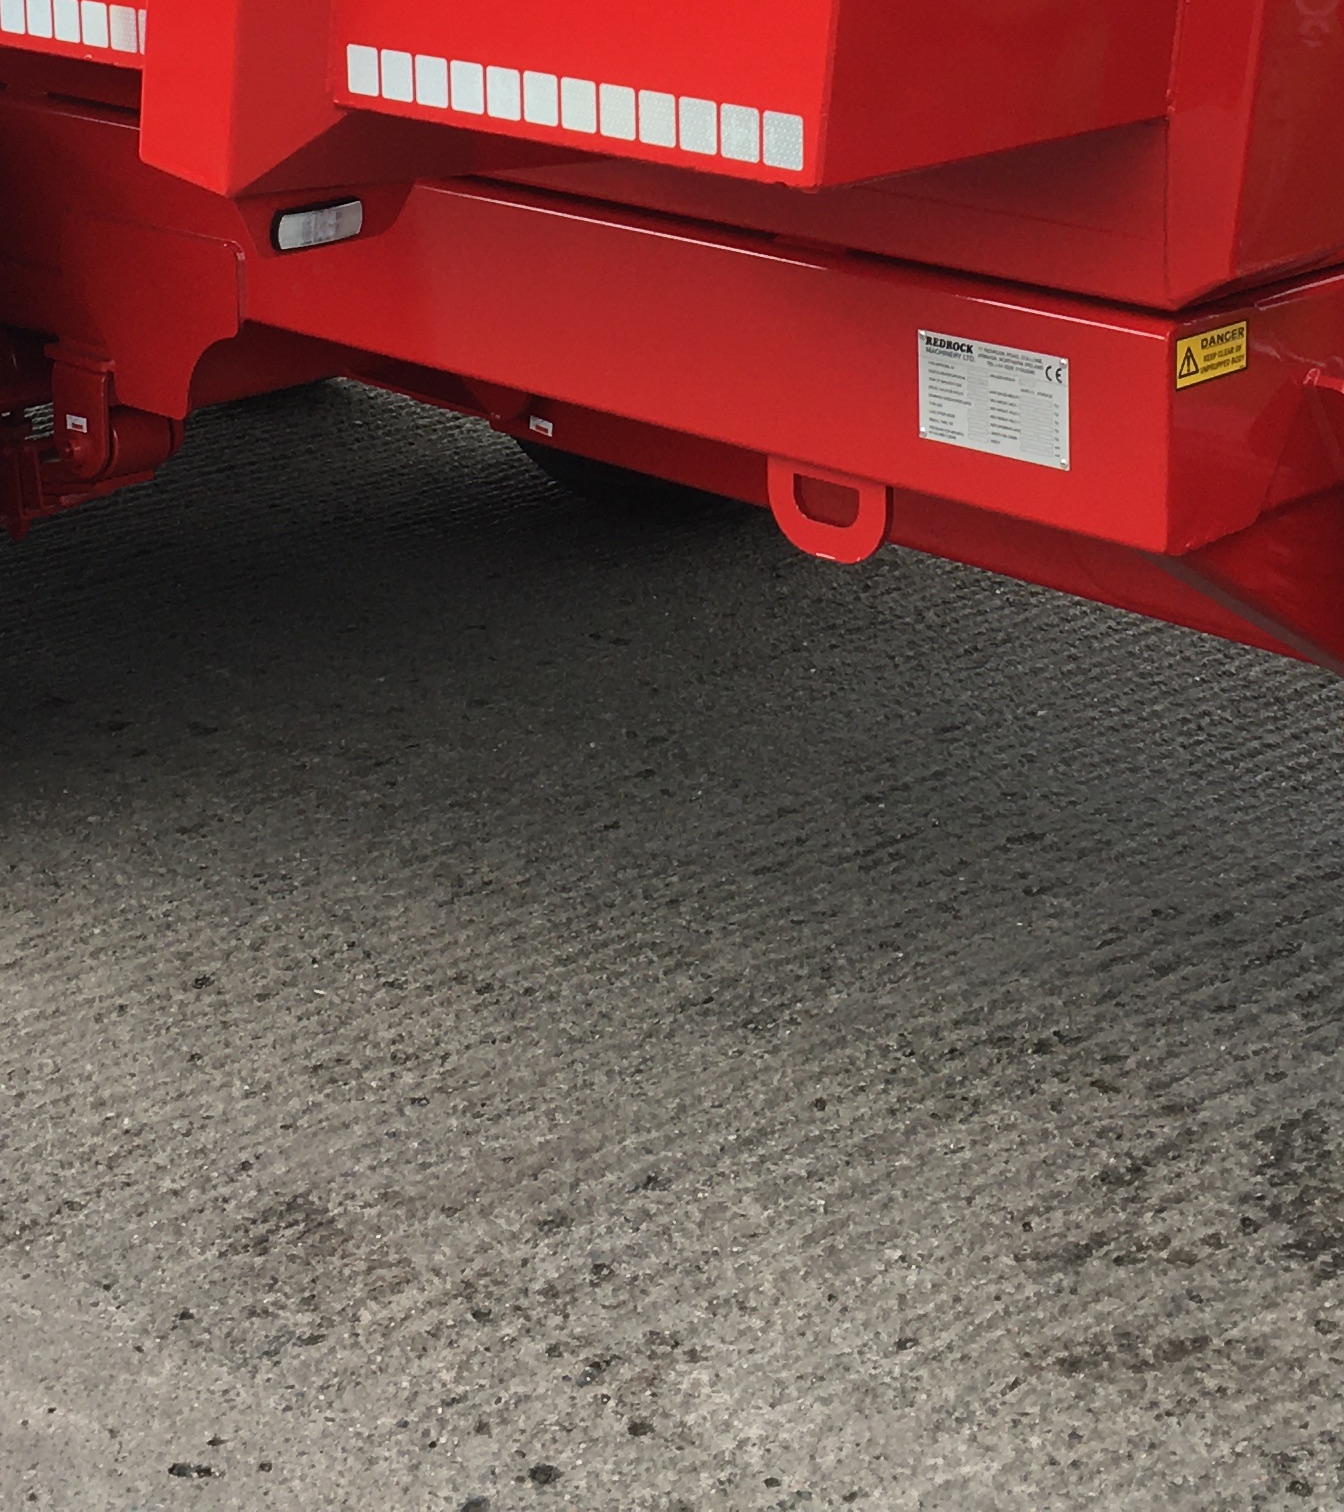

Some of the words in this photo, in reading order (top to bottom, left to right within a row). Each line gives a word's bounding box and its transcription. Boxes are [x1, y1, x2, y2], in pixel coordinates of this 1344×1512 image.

[925, 336, 974, 354] REDROCK
[1200, 327, 1245, 349] DANGER
[925, 347, 962, 361] MACHINERY
[1217, 347, 1234, 358] CLEAR
